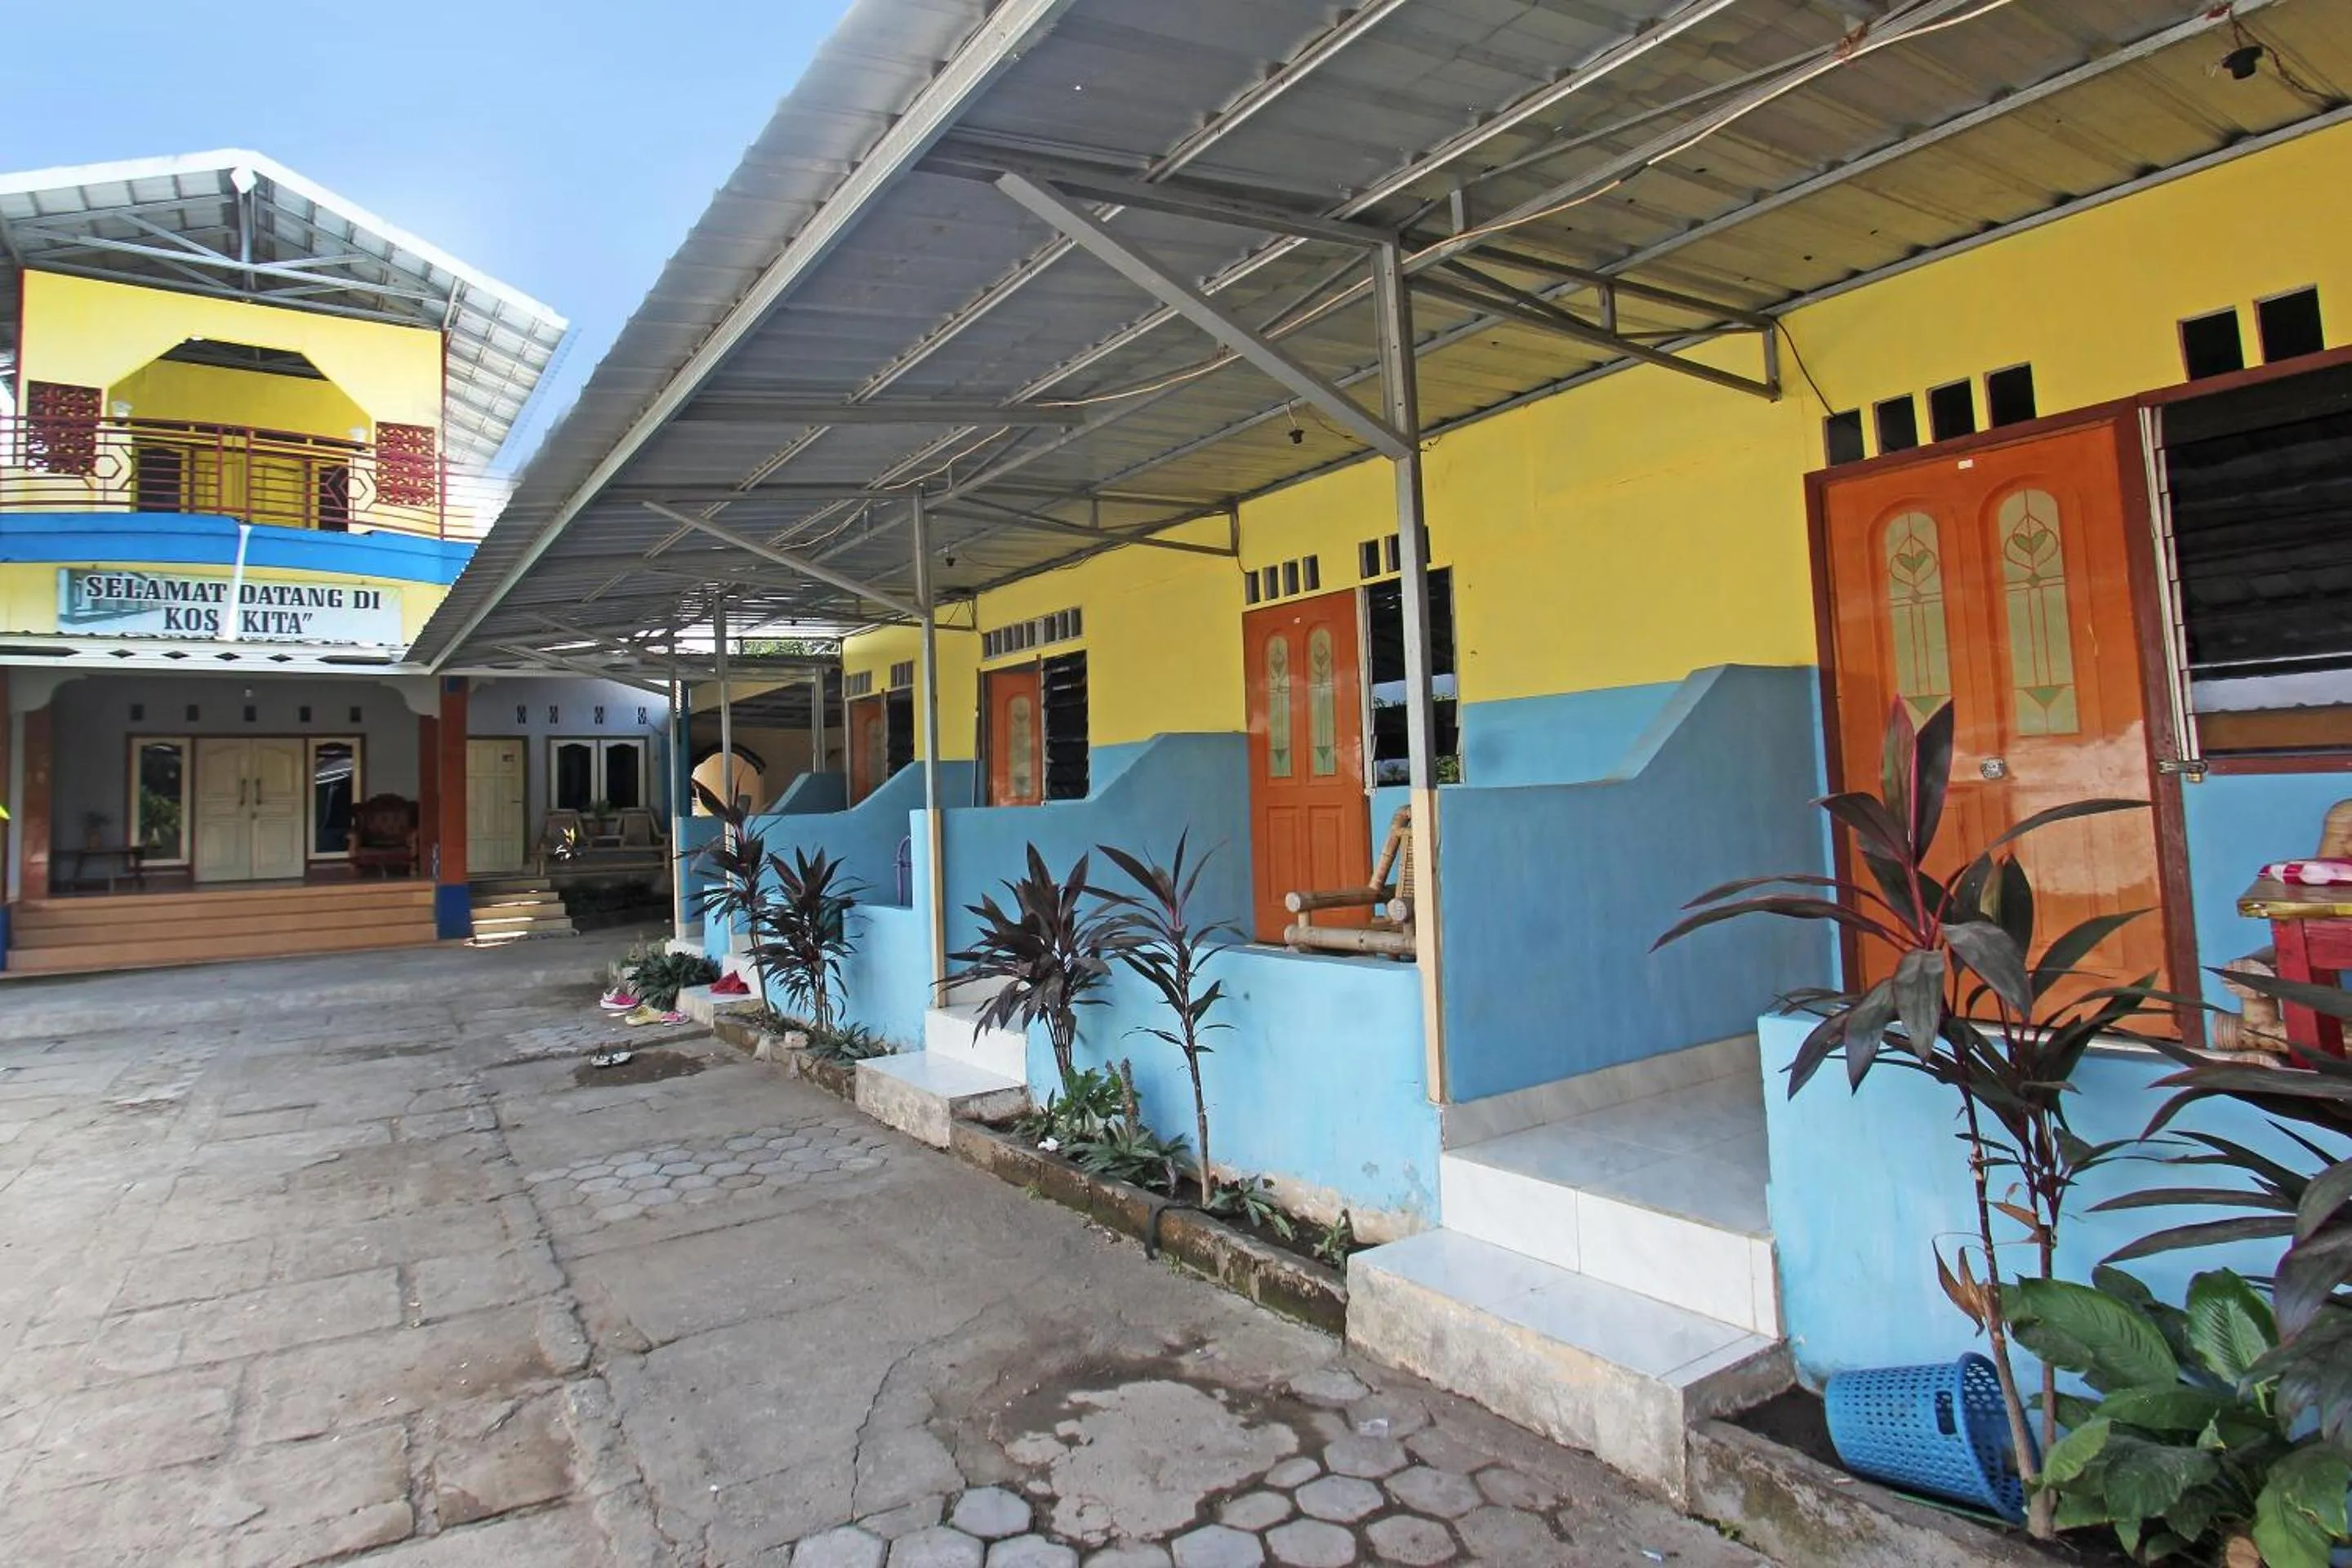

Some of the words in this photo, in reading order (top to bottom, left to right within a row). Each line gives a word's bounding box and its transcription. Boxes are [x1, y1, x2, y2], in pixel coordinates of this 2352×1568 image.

[87, 577, 227, 603] SELAMAT
[239, 584, 342, 608] DATANG
[353, 590, 380, 609] DI
[164, 606, 220, 631] KOS
